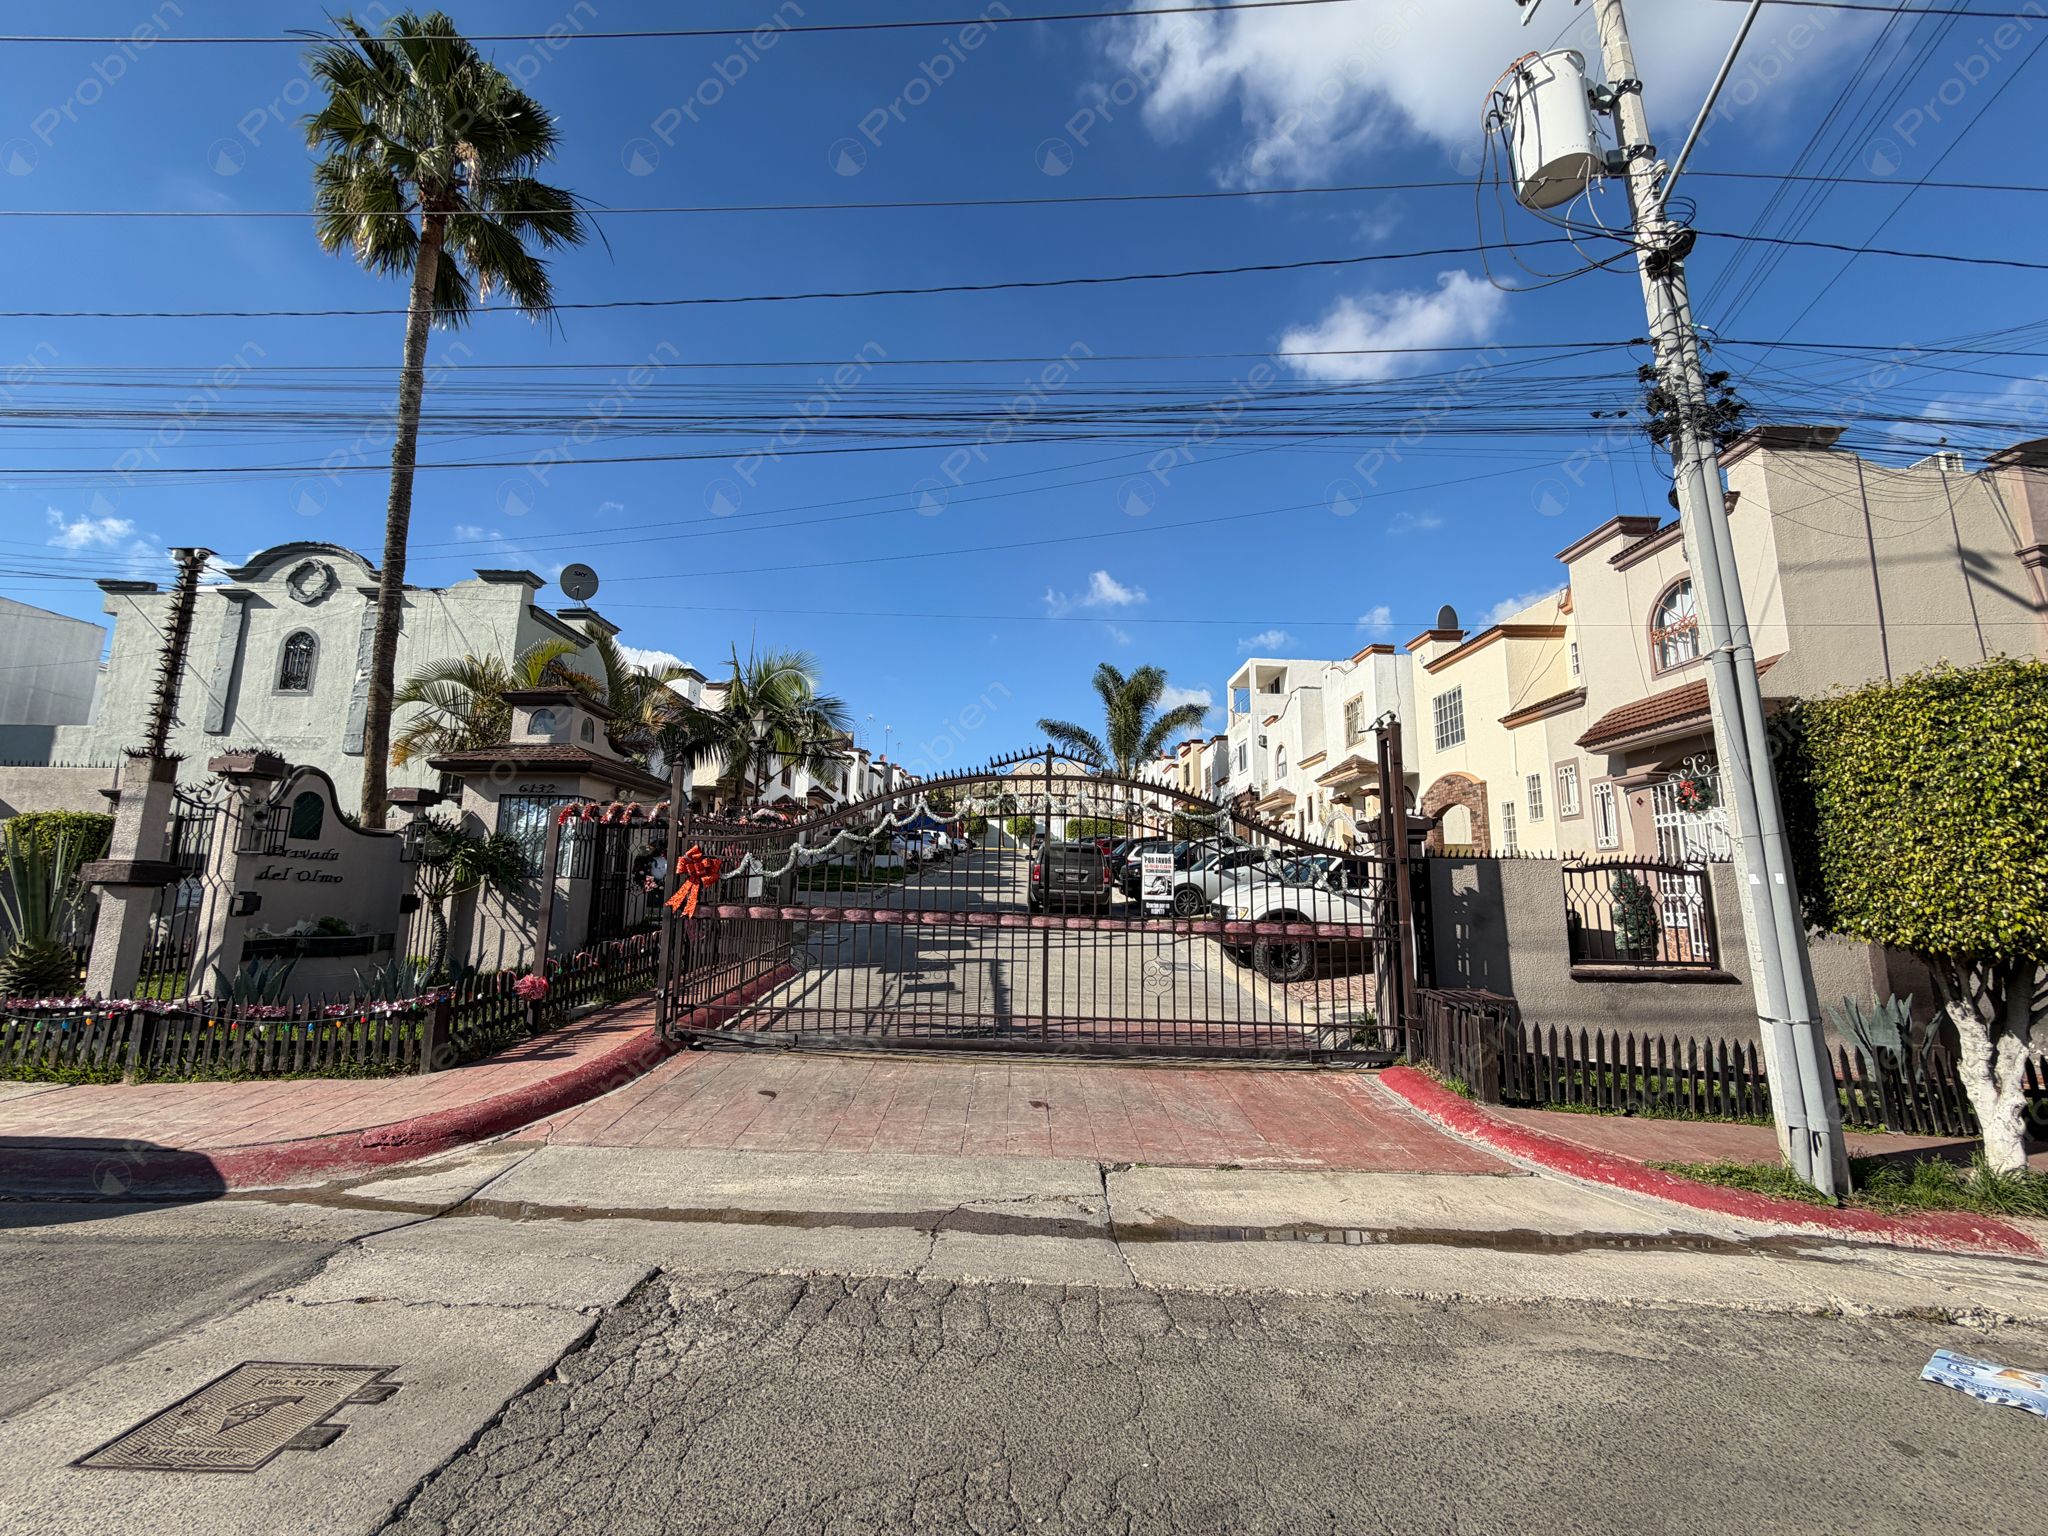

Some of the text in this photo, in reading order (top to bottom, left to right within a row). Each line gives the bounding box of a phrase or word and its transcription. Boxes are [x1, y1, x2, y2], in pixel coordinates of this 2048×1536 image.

[1144, 856, 1172, 864] POR FAVOR
[255, 865, 344, 883] del Olmo
